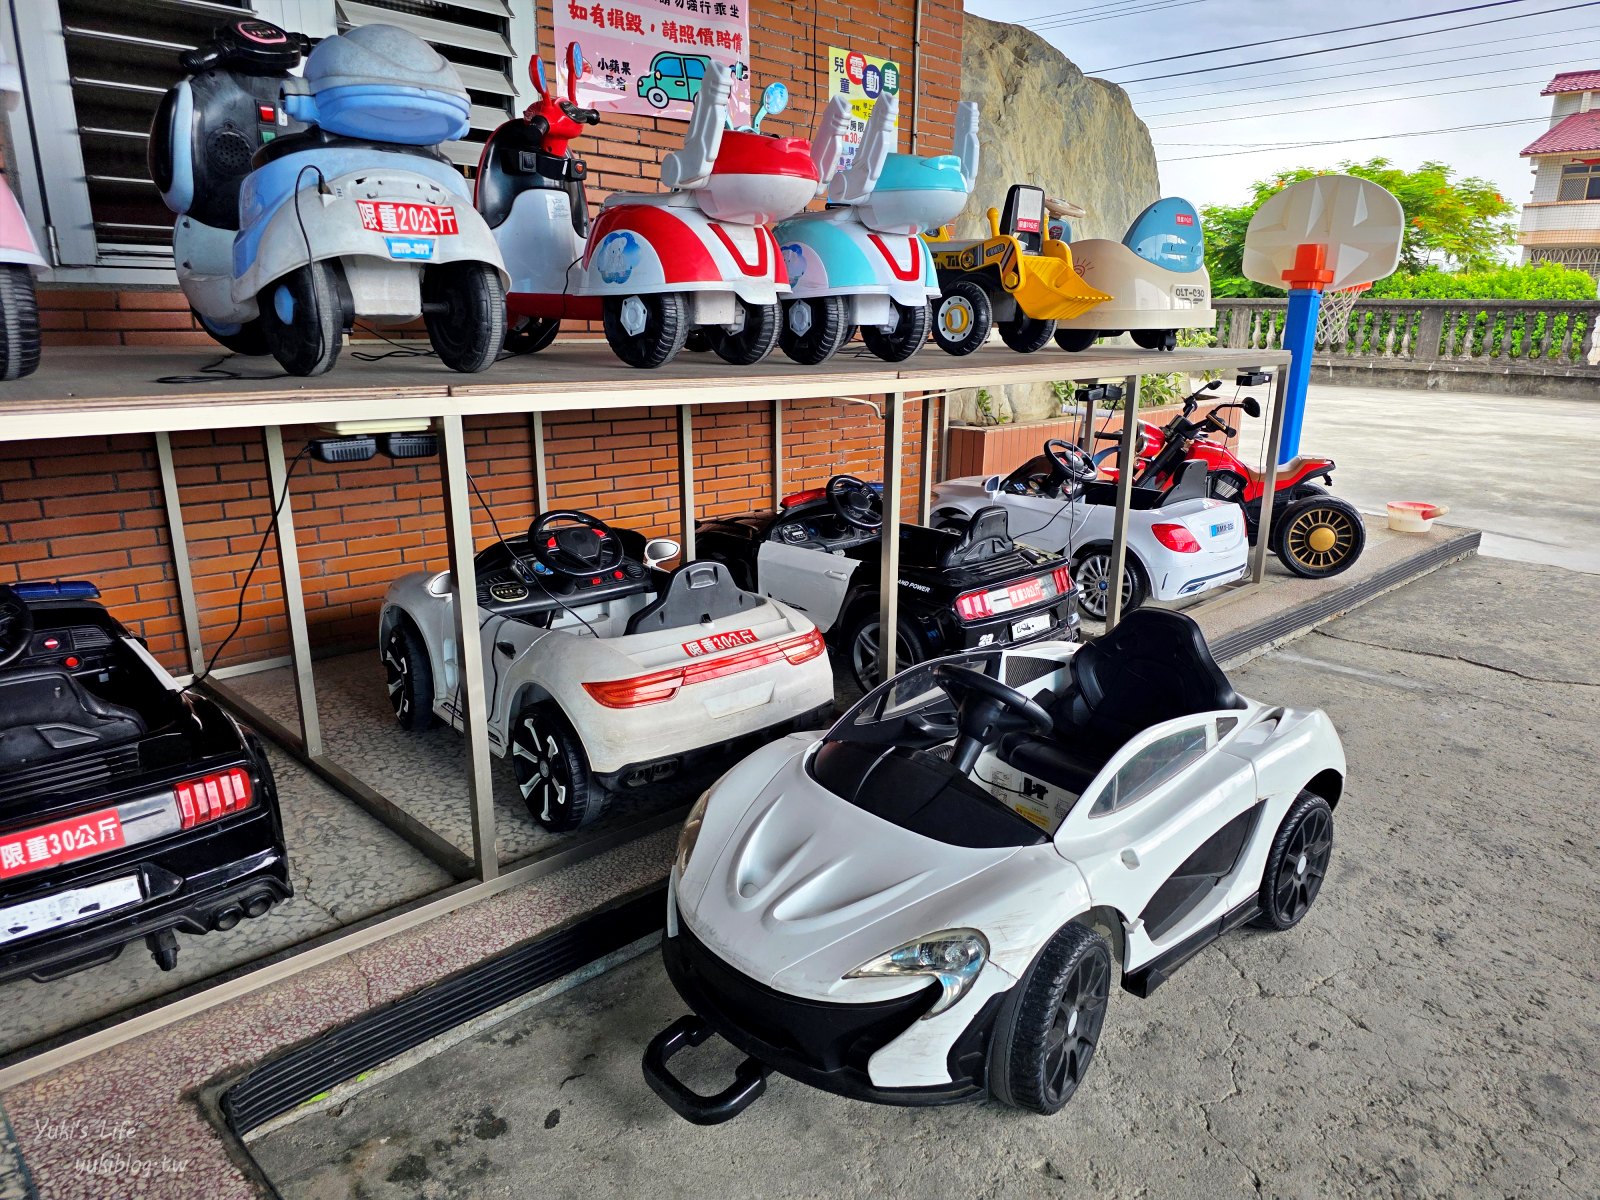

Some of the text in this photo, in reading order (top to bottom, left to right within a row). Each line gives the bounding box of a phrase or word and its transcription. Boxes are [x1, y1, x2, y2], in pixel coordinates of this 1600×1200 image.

[597, 57, 631, 75] 小蘋果
[358, 202, 455, 233] 限重20公斤
[908, 582, 931, 593] POWER
[684, 629, 753, 657] 限重30公斤
[0, 817, 118, 870] 限重30公斤
